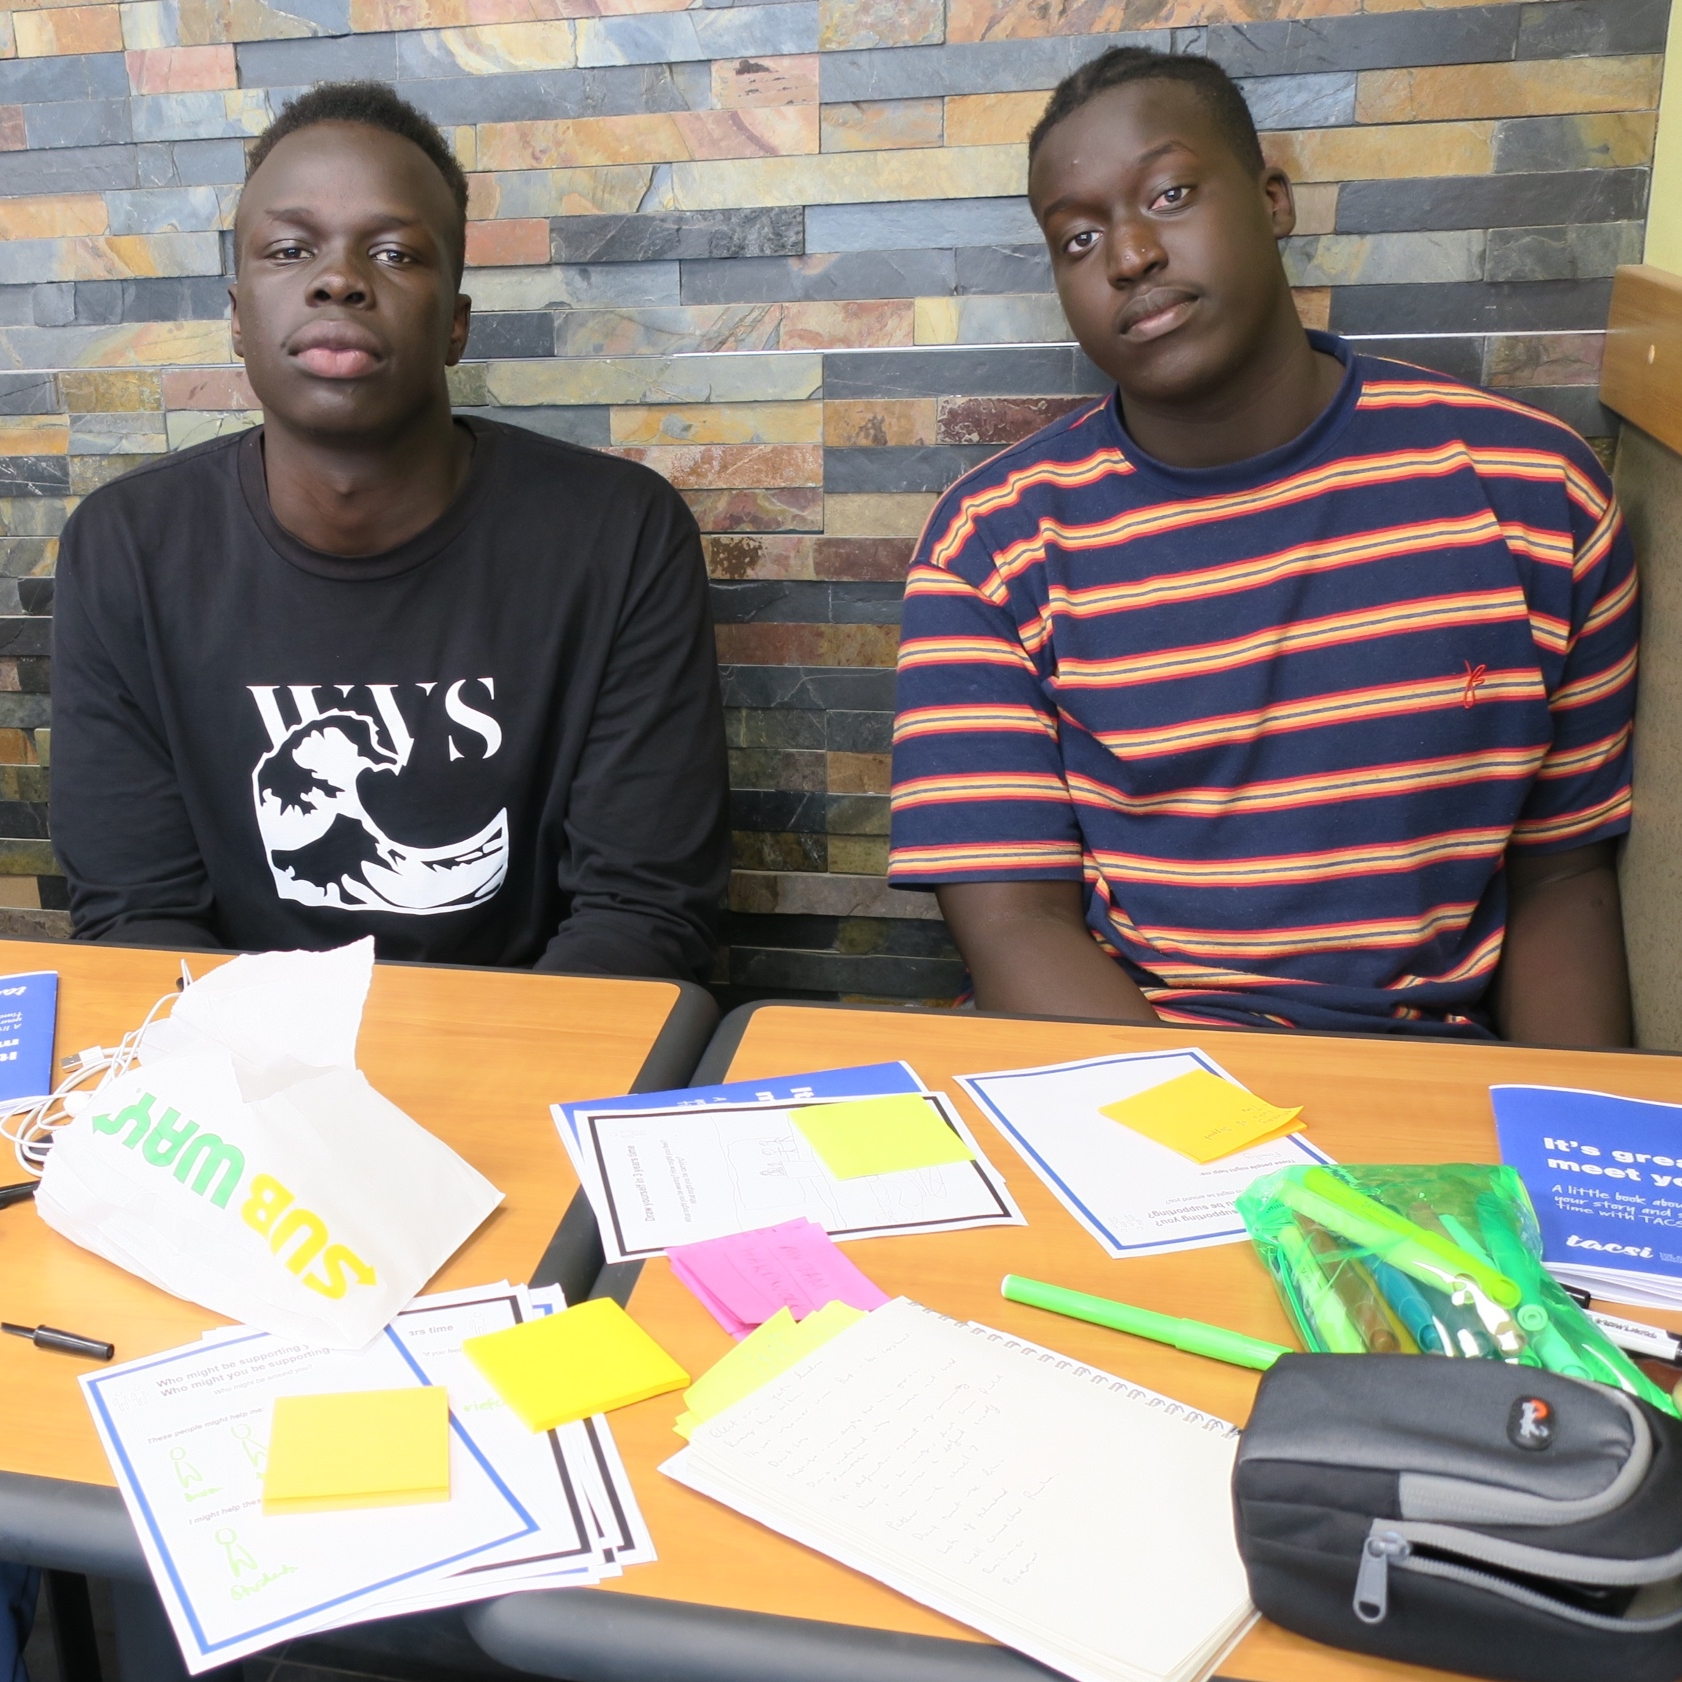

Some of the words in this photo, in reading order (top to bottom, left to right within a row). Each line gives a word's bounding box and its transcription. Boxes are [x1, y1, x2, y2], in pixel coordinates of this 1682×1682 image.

[627, 1145, 637, 1157] time
[1543, 1137, 1601, 1157] It's
[631, 1158, 644, 1172] years
[1229, 1166, 1249, 1174] might
[1274, 1158, 1296, 1166] These
[1547, 1158, 1642, 1182] meet
[91, 1090, 377, 1300] SUBWAY
[636, 1184, 654, 1206] yourself
[1181, 1194, 1206, 1202] around
[1214, 1189, 1236, 1198] might
[1552, 1184, 1563, 1194] A
[1568, 1185, 1610, 1199] little
[1615, 1192, 1647, 1205] book
[1652, 1198, 1682, 1209] abou
[645, 1207, 655, 1222] Draw
[1147, 1204, 1209, 1219] supporting?
[1210, 1201, 1224, 1210] be
[1554, 1196, 1588, 1205] your
[1593, 1201, 1635, 1215] story
[1642, 1207, 1671, 1218] and
[1556, 1202, 1594, 1214] time
[1599, 1210, 1635, 1221] with
[1638, 1214, 1682, 1228] TACS
[1155, 1216, 1181, 1227] you?
[1183, 1209, 1238, 1223] supporting
[1565, 1234, 1654, 1259] tacsi
[408, 1328, 426, 1336] ars
[429, 1325, 454, 1334] time
[156, 1375, 183, 1388] Who
[186, 1364, 220, 1380] might
[221, 1360, 236, 1369] be
[239, 1344, 301, 1364] supporting
[160, 1385, 188, 1397] Who
[191, 1375, 225, 1390] might
[226, 1368, 249, 1381] you
[250, 1364, 266, 1373] be
[213, 1386, 233, 1396] Who
[233, 1380, 254, 1391] might
[256, 1376, 266, 1384] be
[266, 1369, 294, 1383] around
[294, 1363, 313, 1375] you?
[147, 1433, 172, 1445] These
[174, 1424, 203, 1438] people
[204, 1416, 228, 1428] might
[230, 1411, 248, 1421] help
[194, 1510, 220, 1524] might
[221, 1504, 242, 1515] help
[243, 1498, 262, 1509] thes
